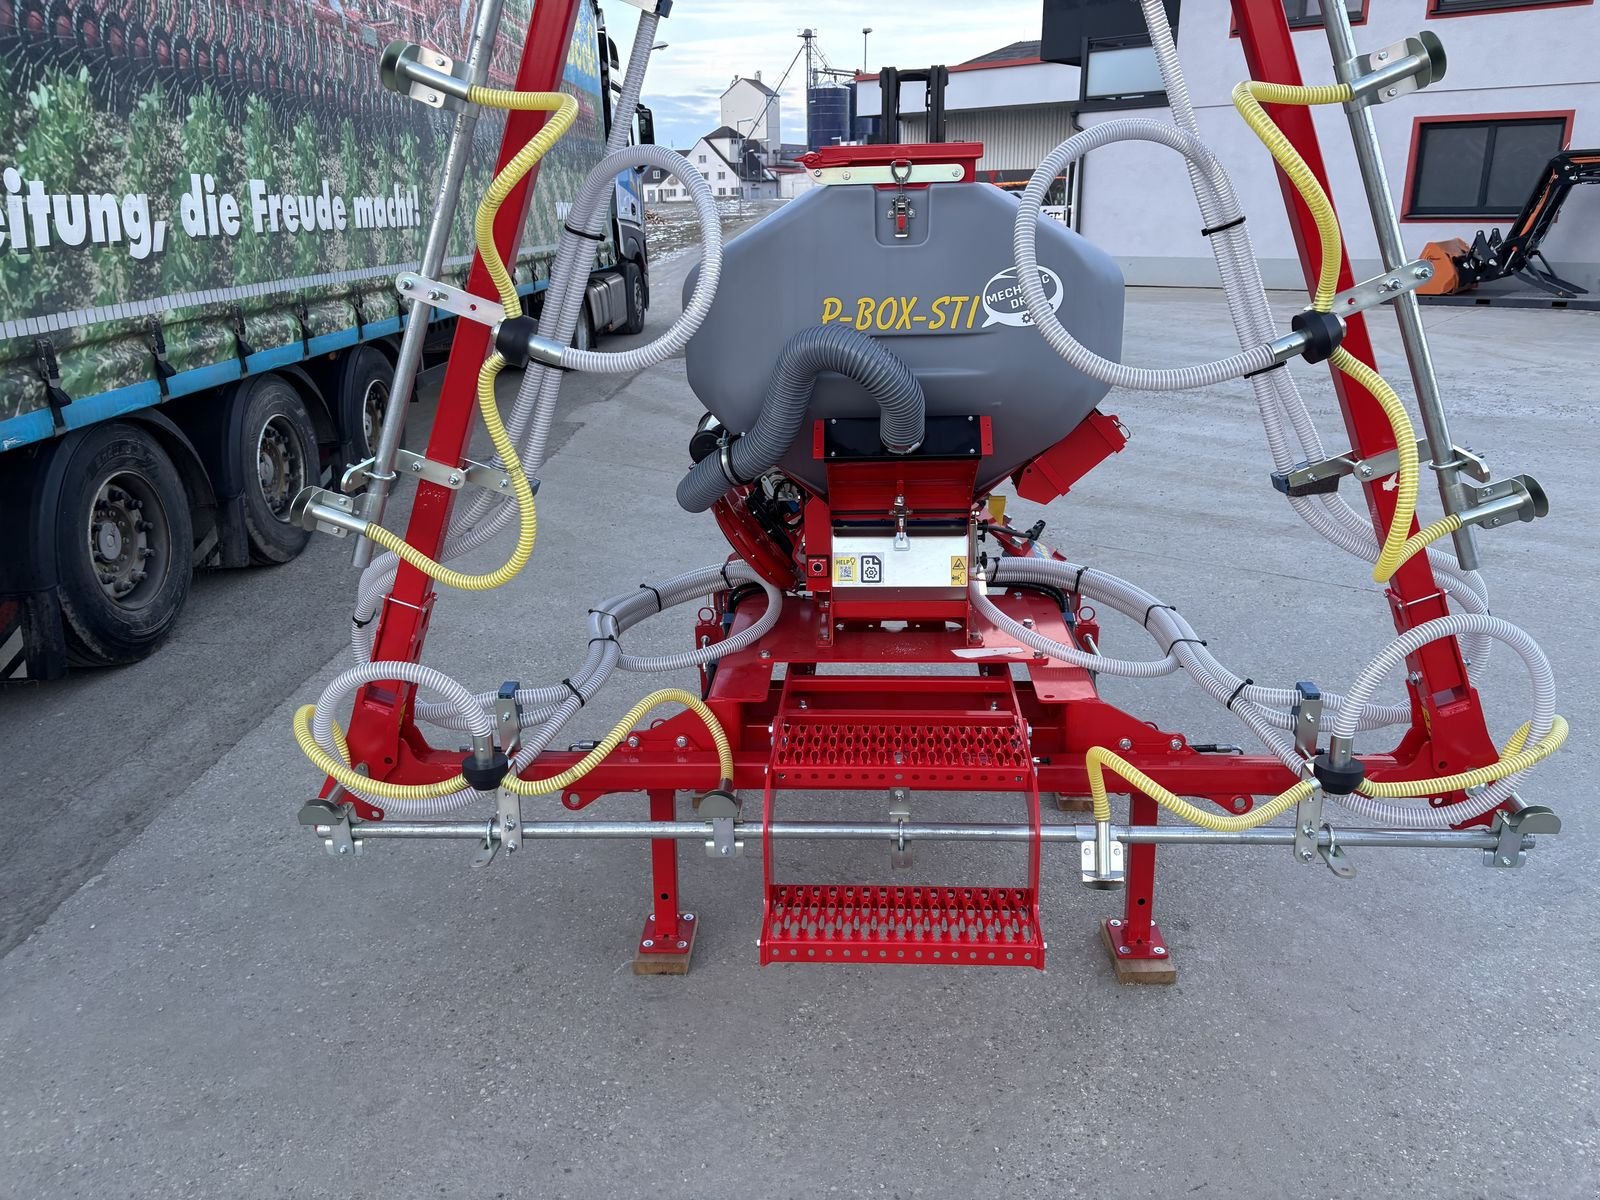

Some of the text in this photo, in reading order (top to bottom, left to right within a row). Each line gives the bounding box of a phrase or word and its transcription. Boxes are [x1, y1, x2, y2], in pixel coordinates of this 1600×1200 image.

[0, 167, 421, 260] itung, die Freude macht!
[986, 273, 1050, 305] MECHC
[822, 295, 980, 330] P-BOX-STI
